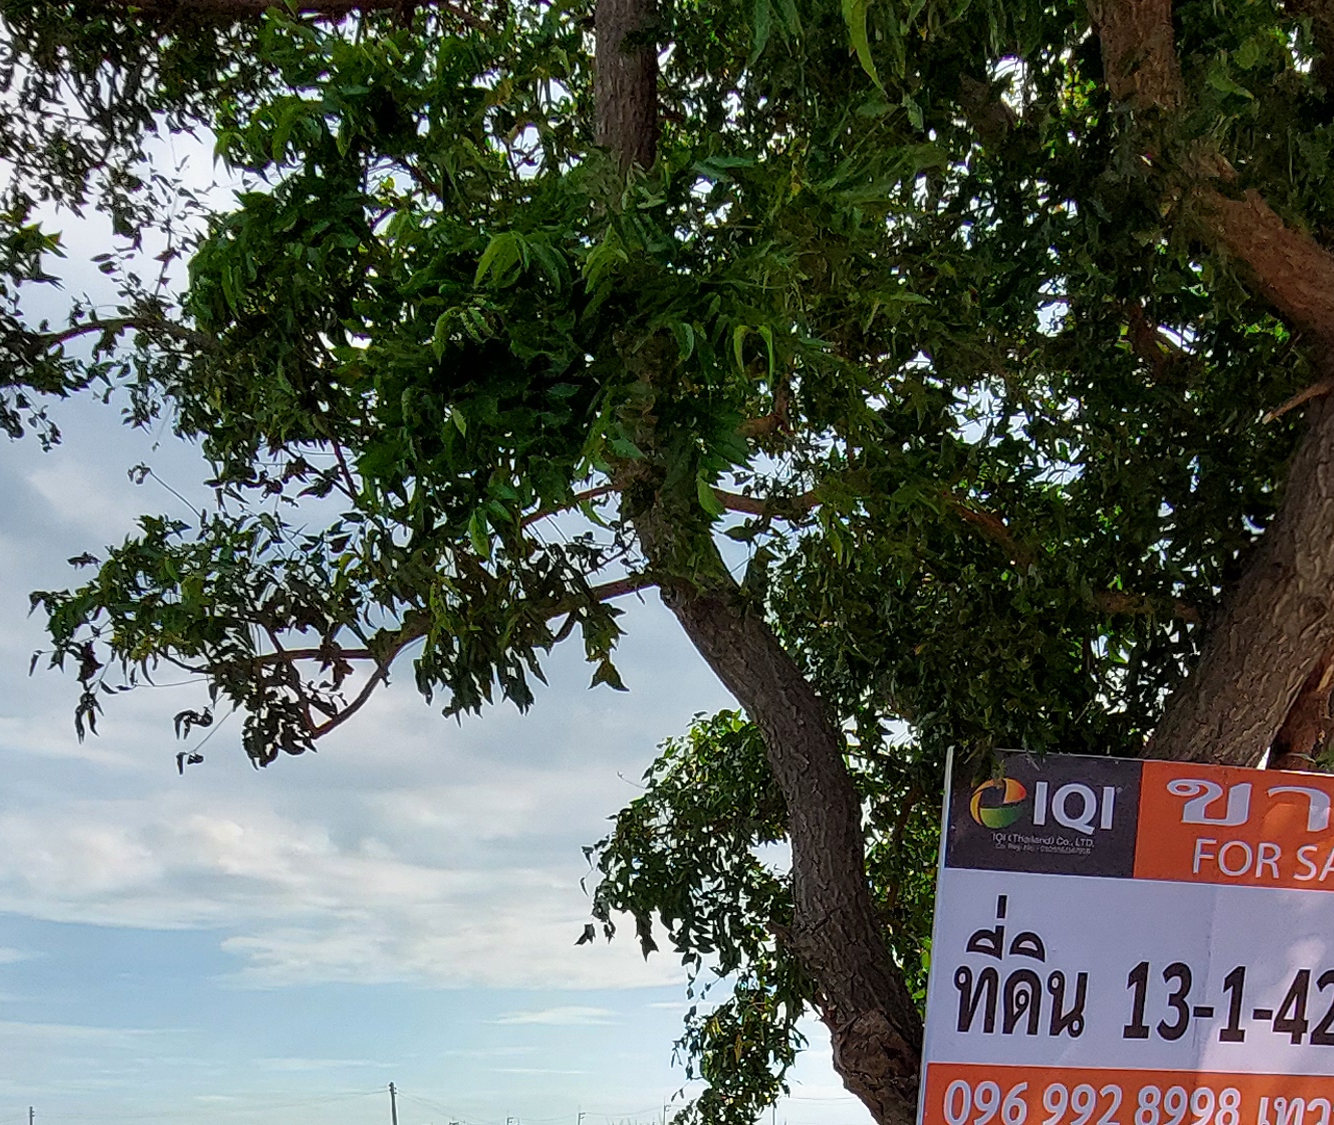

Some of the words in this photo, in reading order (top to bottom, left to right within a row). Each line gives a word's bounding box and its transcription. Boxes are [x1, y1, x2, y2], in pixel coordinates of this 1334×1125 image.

[1033, 781, 1115, 834] IQI
[1192, 837, 1281, 879] FOR
[953, 894, 1089, 1039] ที่ดิน
